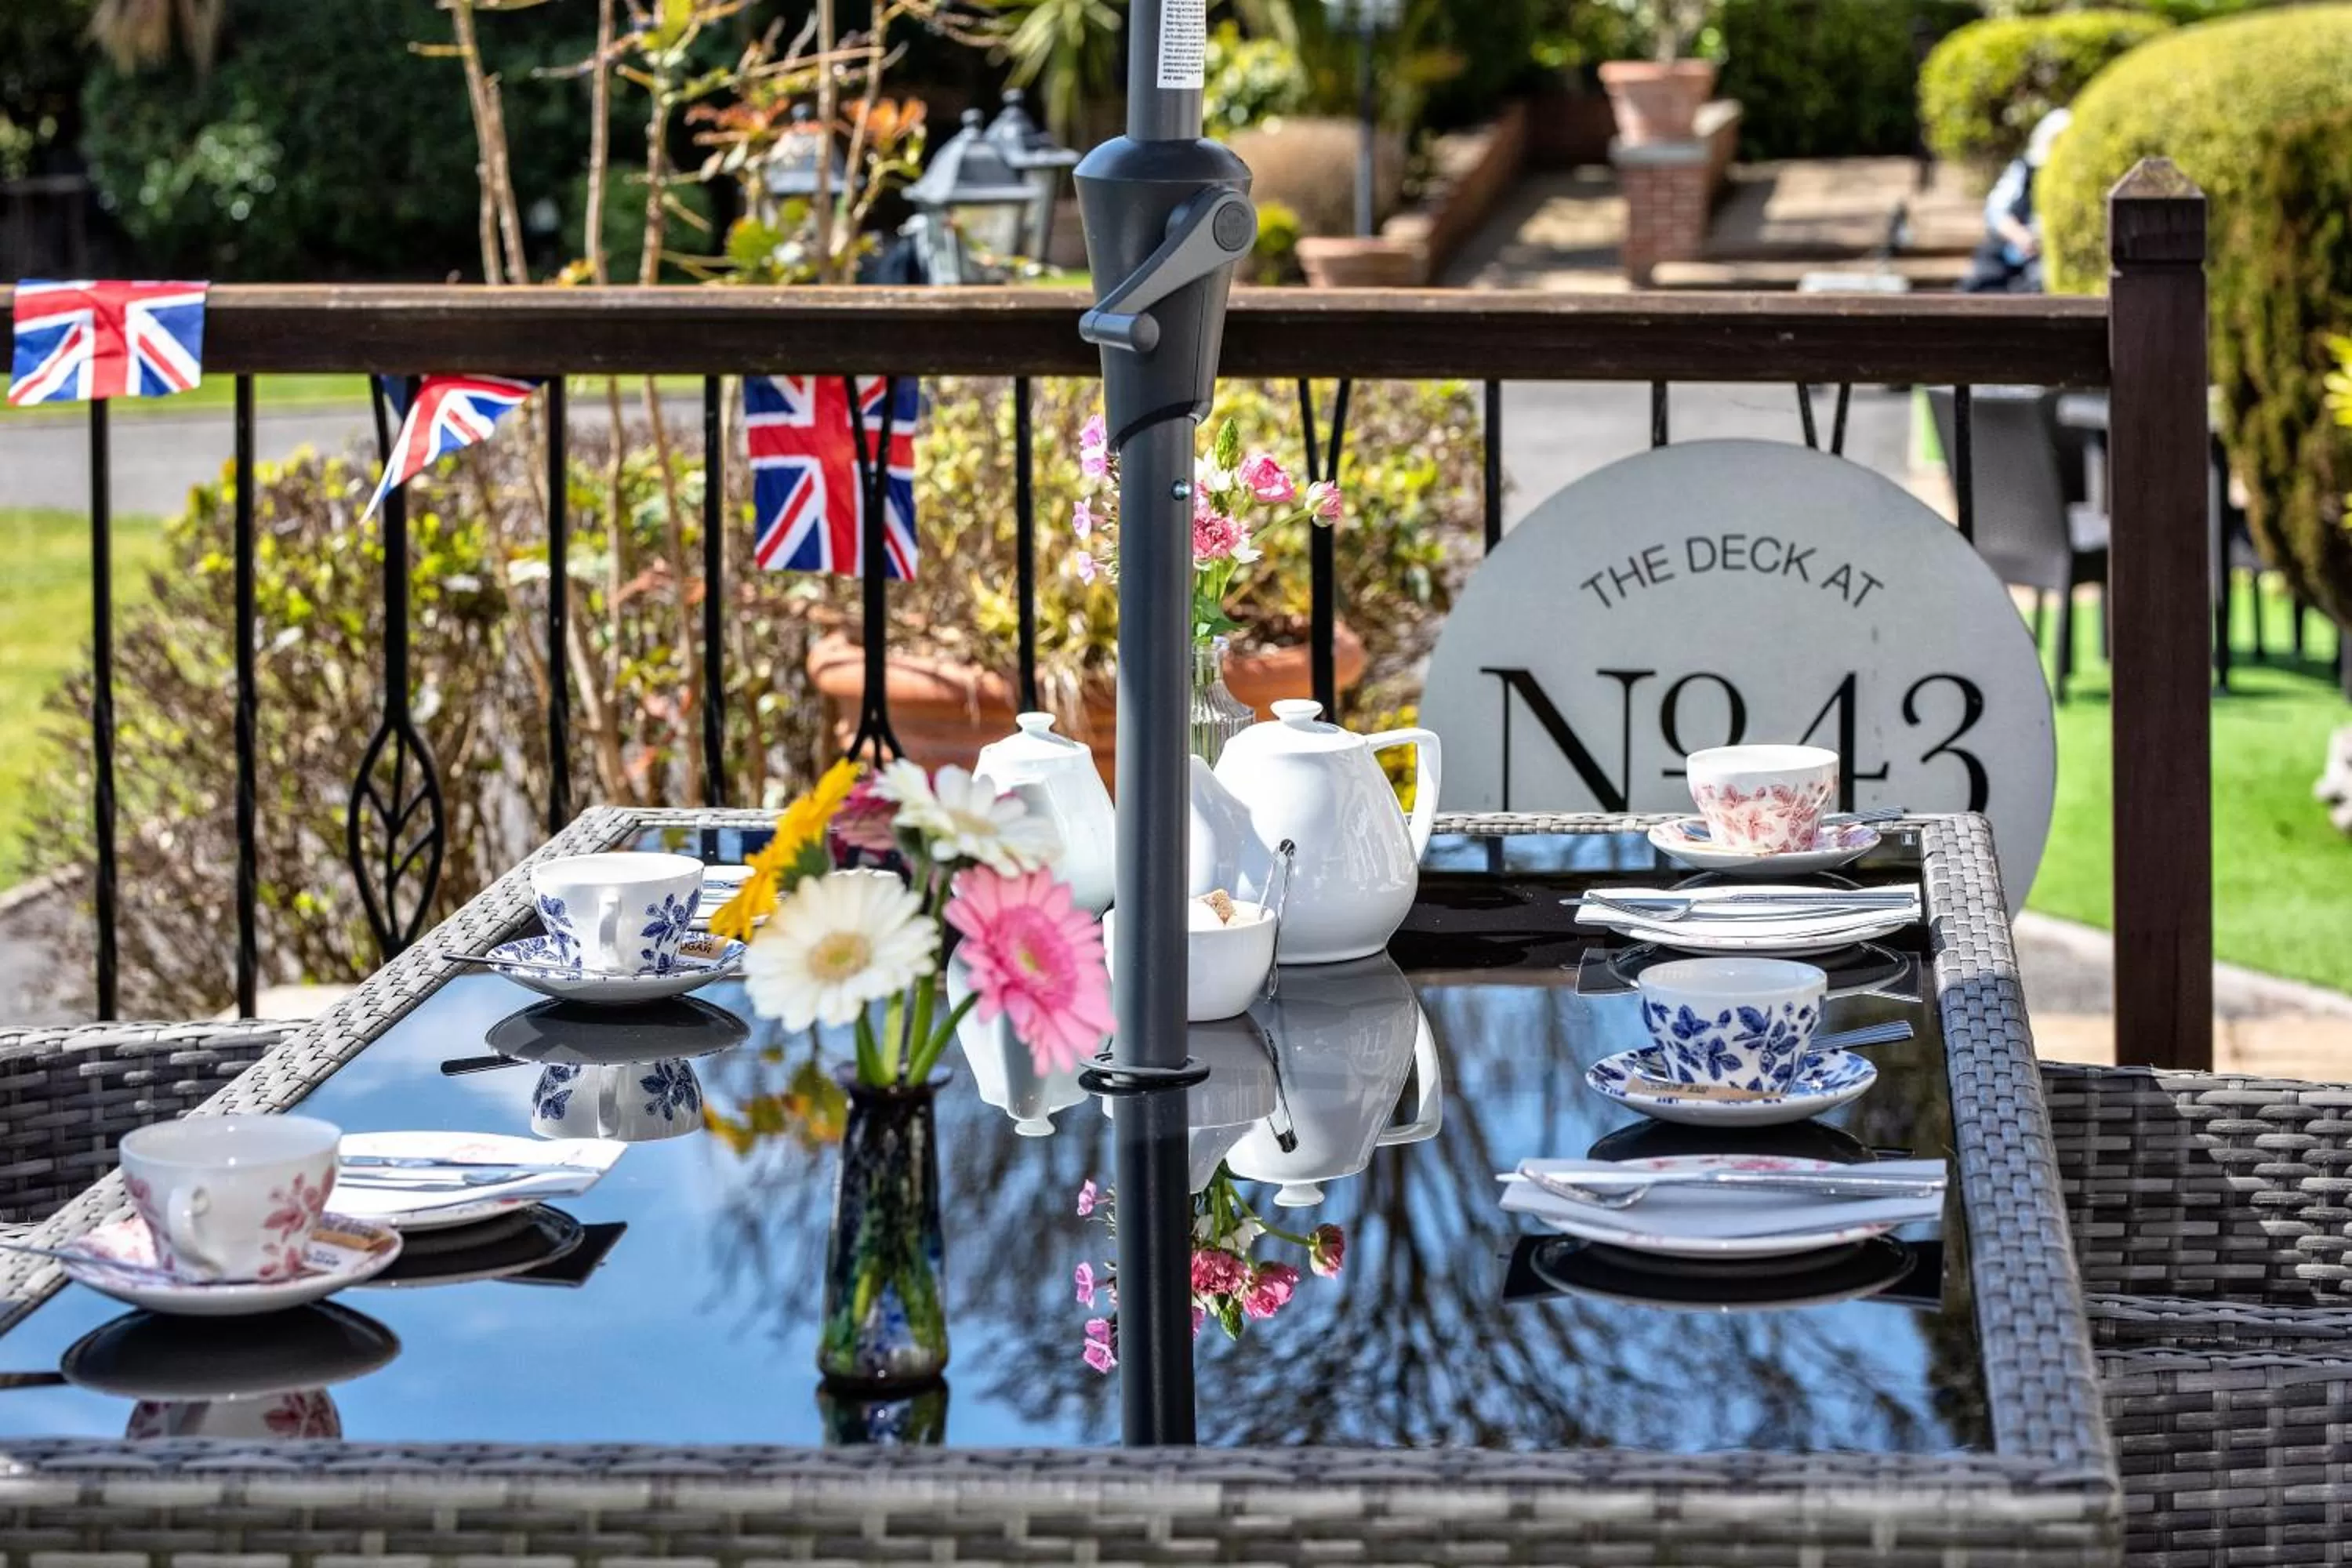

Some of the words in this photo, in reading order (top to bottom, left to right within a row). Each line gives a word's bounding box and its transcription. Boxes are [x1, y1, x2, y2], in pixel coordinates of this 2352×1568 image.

[1579, 543, 1675, 609] THE
[1685, 534, 1818, 583] DECK
[1820, 562, 1885, 608] AT
